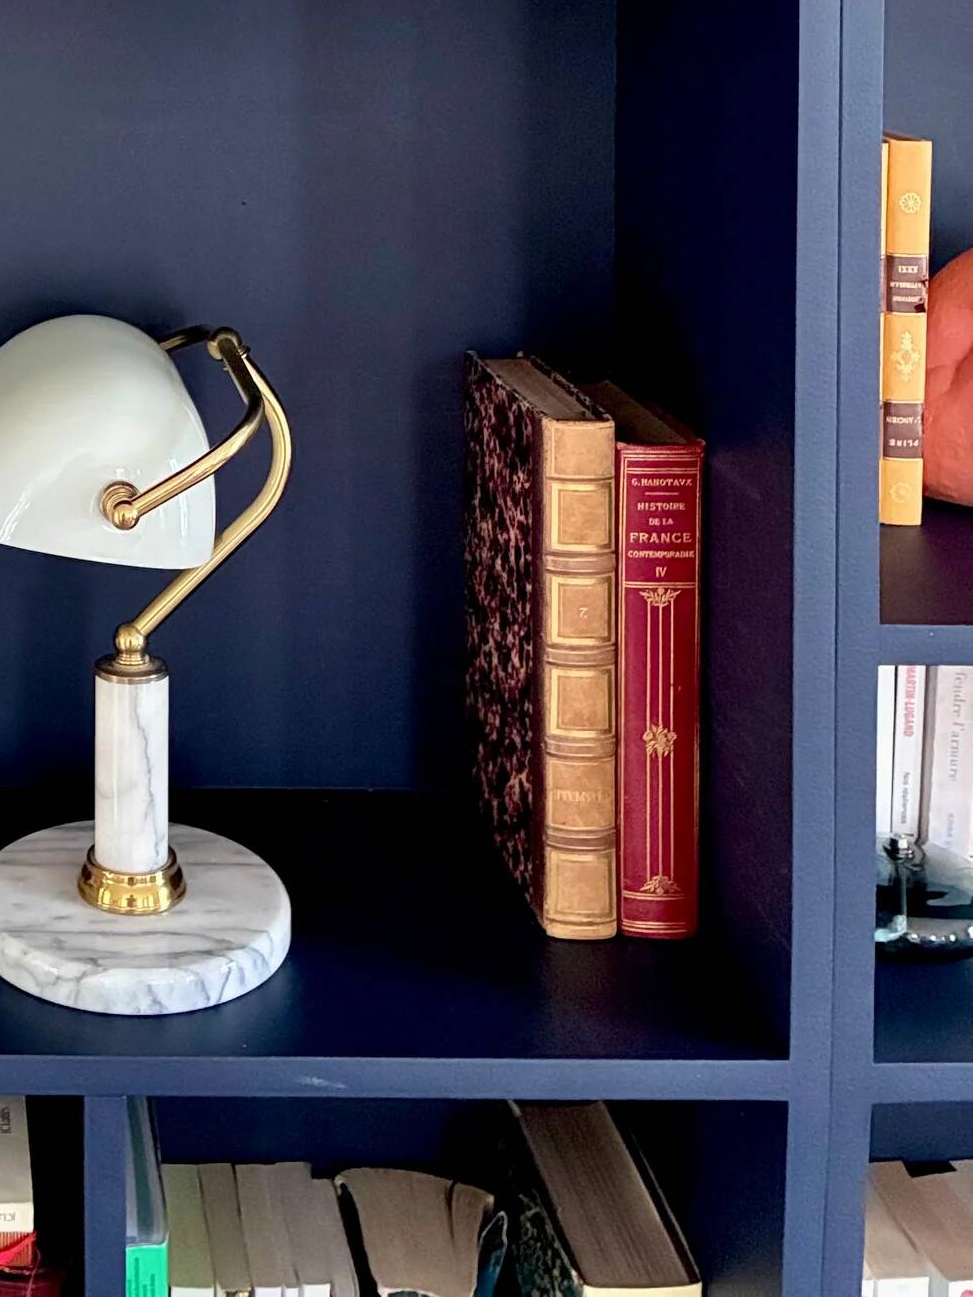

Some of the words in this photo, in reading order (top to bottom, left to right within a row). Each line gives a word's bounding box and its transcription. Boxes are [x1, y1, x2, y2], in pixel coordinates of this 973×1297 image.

[888, 438, 920, 448] PLINE
[637, 501, 686, 511] HISTOIRE
[648, 517, 660, 526] DE
[661, 517, 674, 525] LA
[629, 531, 693, 544] FRANCE
[627, 550, 695, 559] CONTEMPORAINE
[655, 566, 667, 578] IV
[948, 720, 966, 783] l'armure
